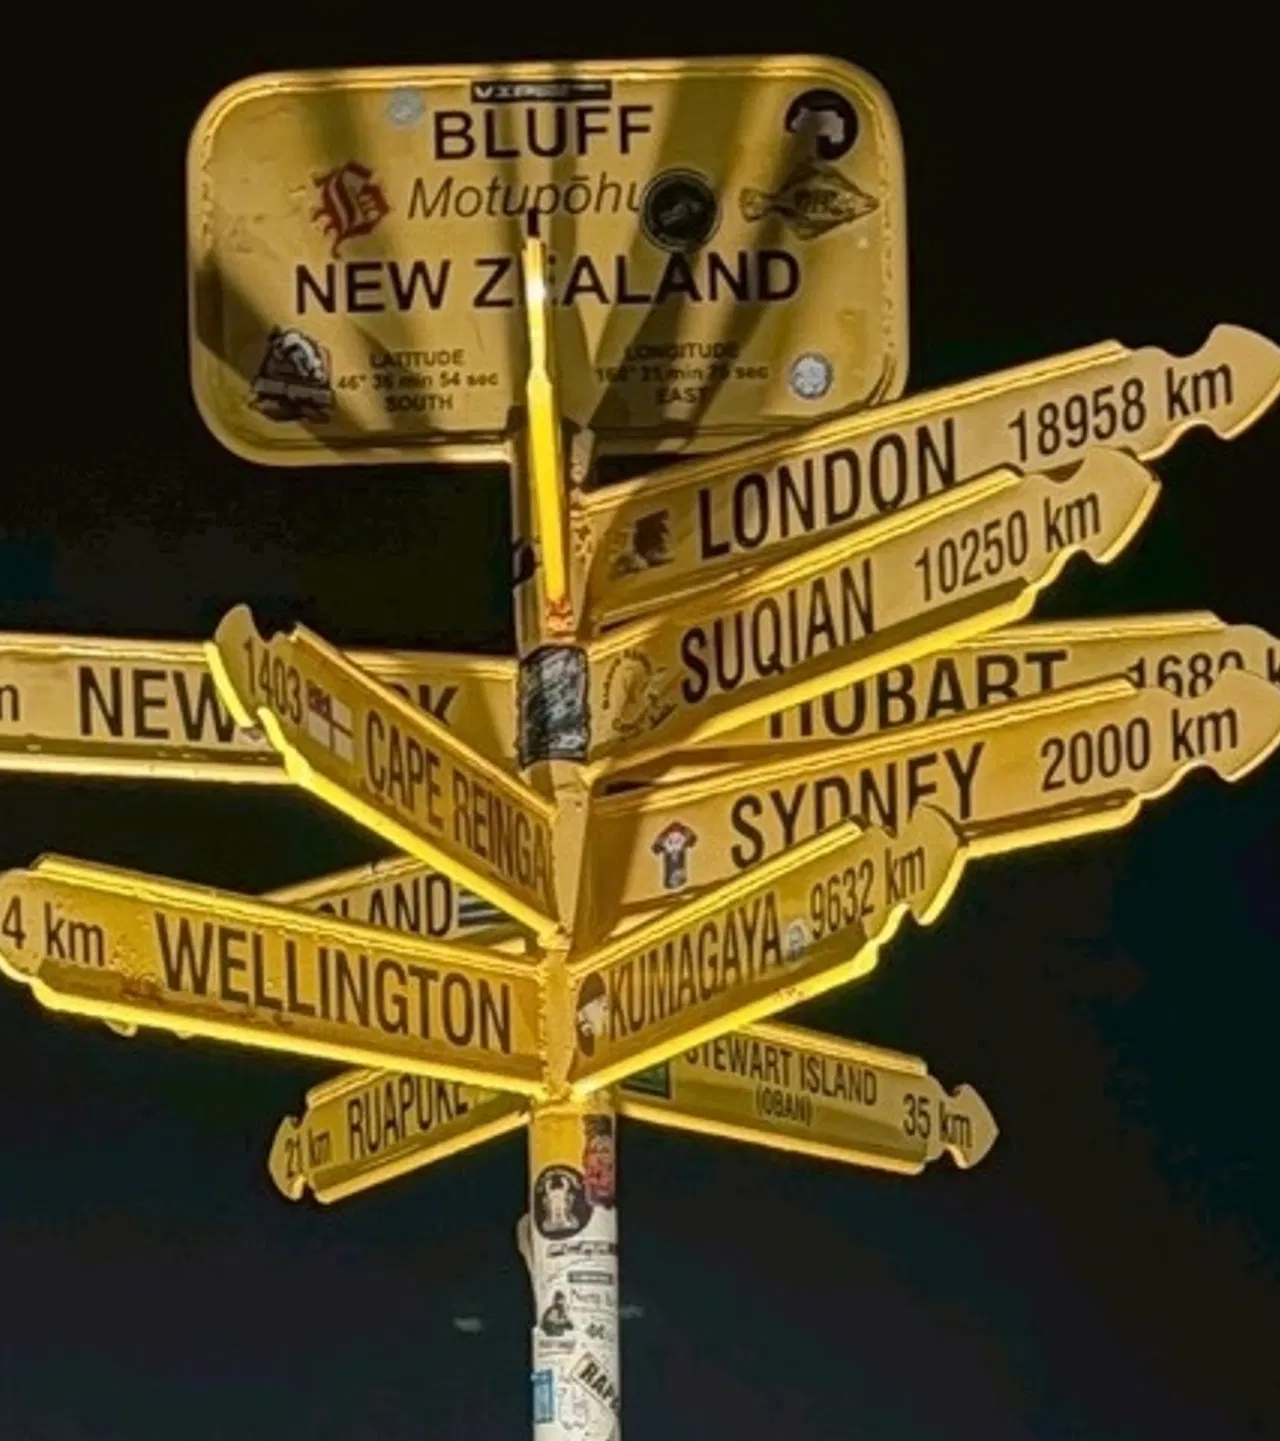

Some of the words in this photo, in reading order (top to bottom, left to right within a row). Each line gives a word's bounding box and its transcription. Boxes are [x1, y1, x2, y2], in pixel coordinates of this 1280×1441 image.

[433, 104, 653, 160] BLUFF
[407, 172, 640, 222] Motupōhu
[296, 258, 452, 315] NEW
[473, 250, 802, 308] ZALAND
[370, 348, 466, 368] LATITUDE
[624, 341, 741, 361] LONGITUDE
[734, 364, 770, 380] sec
[386, 392, 455, 412] SOUTH
[466, 372, 500, 387] sec
[659, 385, 708, 404] EAST
[698, 417, 956, 560] LONDON
[1008, 378, 1147, 463] 18958
[1166, 361, 1235, 419] km
[680, 557, 875, 704] SUQIAN
[915, 509, 1029, 603] 10250
[1045, 490, 1102, 555] km
[78, 664, 232, 744] NEW
[243, 640, 301, 726] 1403
[365, 709, 444, 832] CAPE
[452, 771, 550, 915] REINGA
[730, 742, 985, 870] SYDNEY
[1041, 717, 1152, 793] 2000
[1171, 706, 1240, 762] km
[608, 890, 782, 1043] KUMAGAYA
[809, 858, 875, 943] 9632
[884, 845, 926, 904] km
[44, 901, 106, 967] km
[155, 911, 513, 1055] WELLINGTON
[684, 1035, 792, 1088] STEWART
[799, 1055, 878, 1106] ISLAND
[755, 1085, 814, 1126] (OBAN)
[902, 1093, 932, 1140] 35
[938, 1100, 973, 1149] km
[308, 1128, 332, 1168] km
